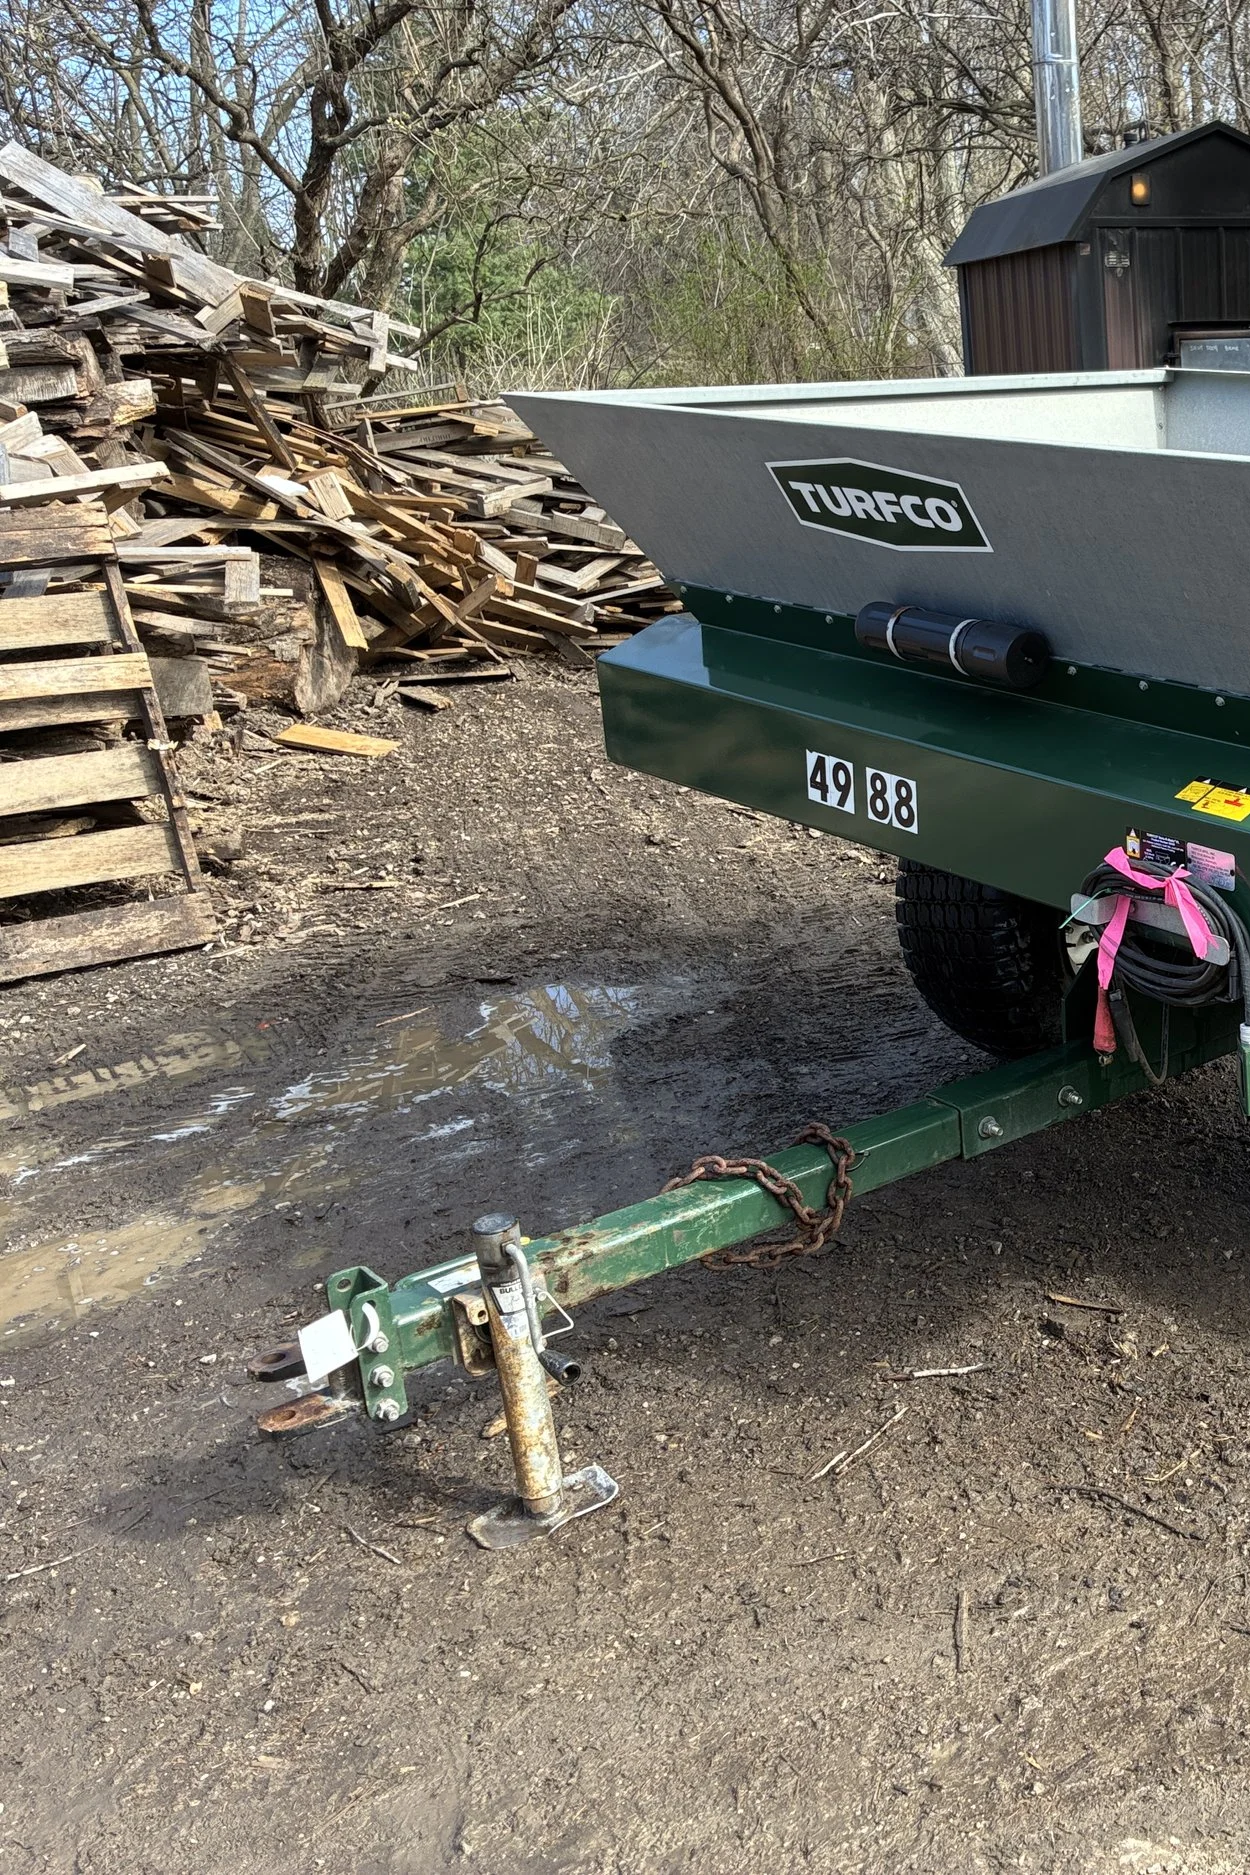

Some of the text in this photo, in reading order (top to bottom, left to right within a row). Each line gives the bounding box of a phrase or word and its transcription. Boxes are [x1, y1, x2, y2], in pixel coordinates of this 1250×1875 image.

[788, 480, 963, 532] TURFCO
[809, 755, 915, 828] 49 88
